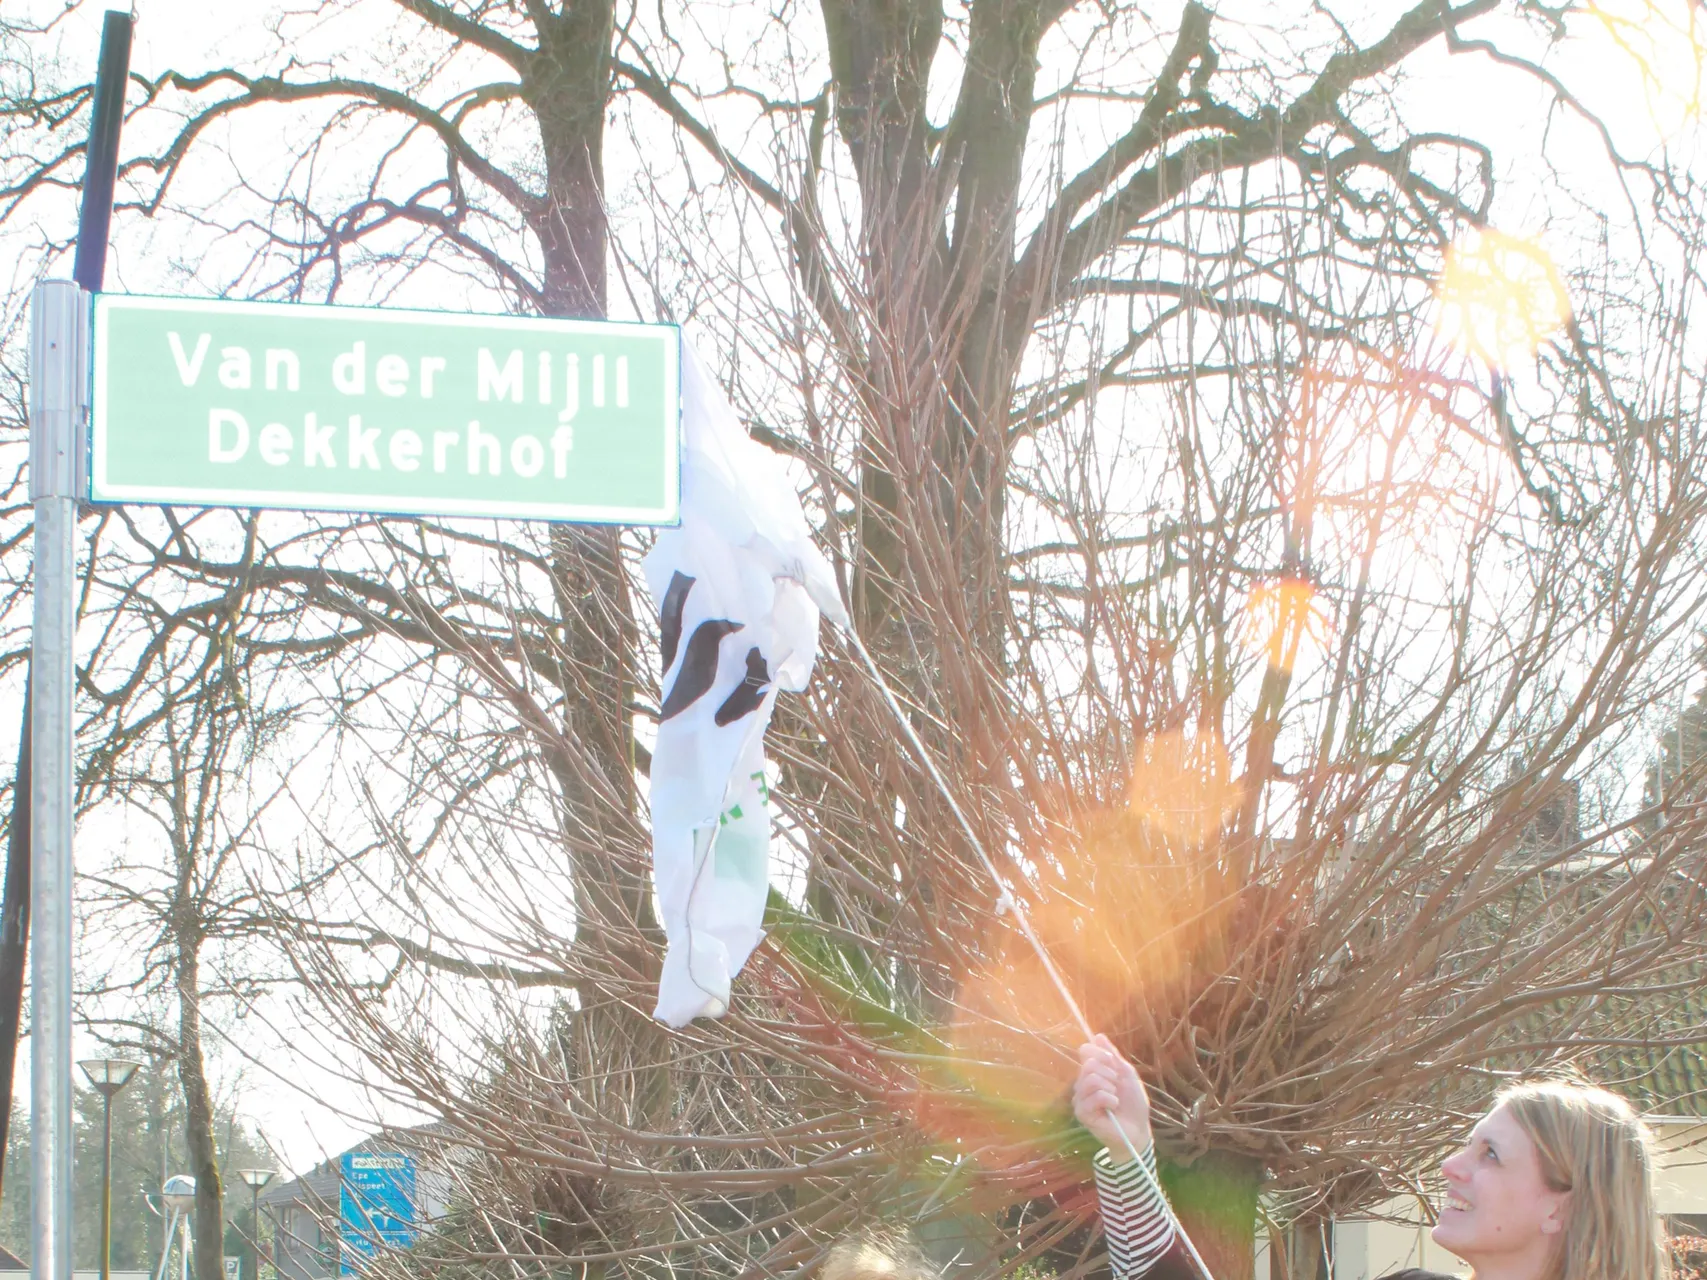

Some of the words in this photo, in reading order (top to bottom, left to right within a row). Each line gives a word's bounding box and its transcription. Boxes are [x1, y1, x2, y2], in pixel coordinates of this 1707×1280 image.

[166, 331, 301, 392] Van
[332, 340, 446, 399] der
[476, 347, 630, 423] Mijll
[207, 407, 575, 480] Dekkerhof
[226, 1261, 235, 1272] P
